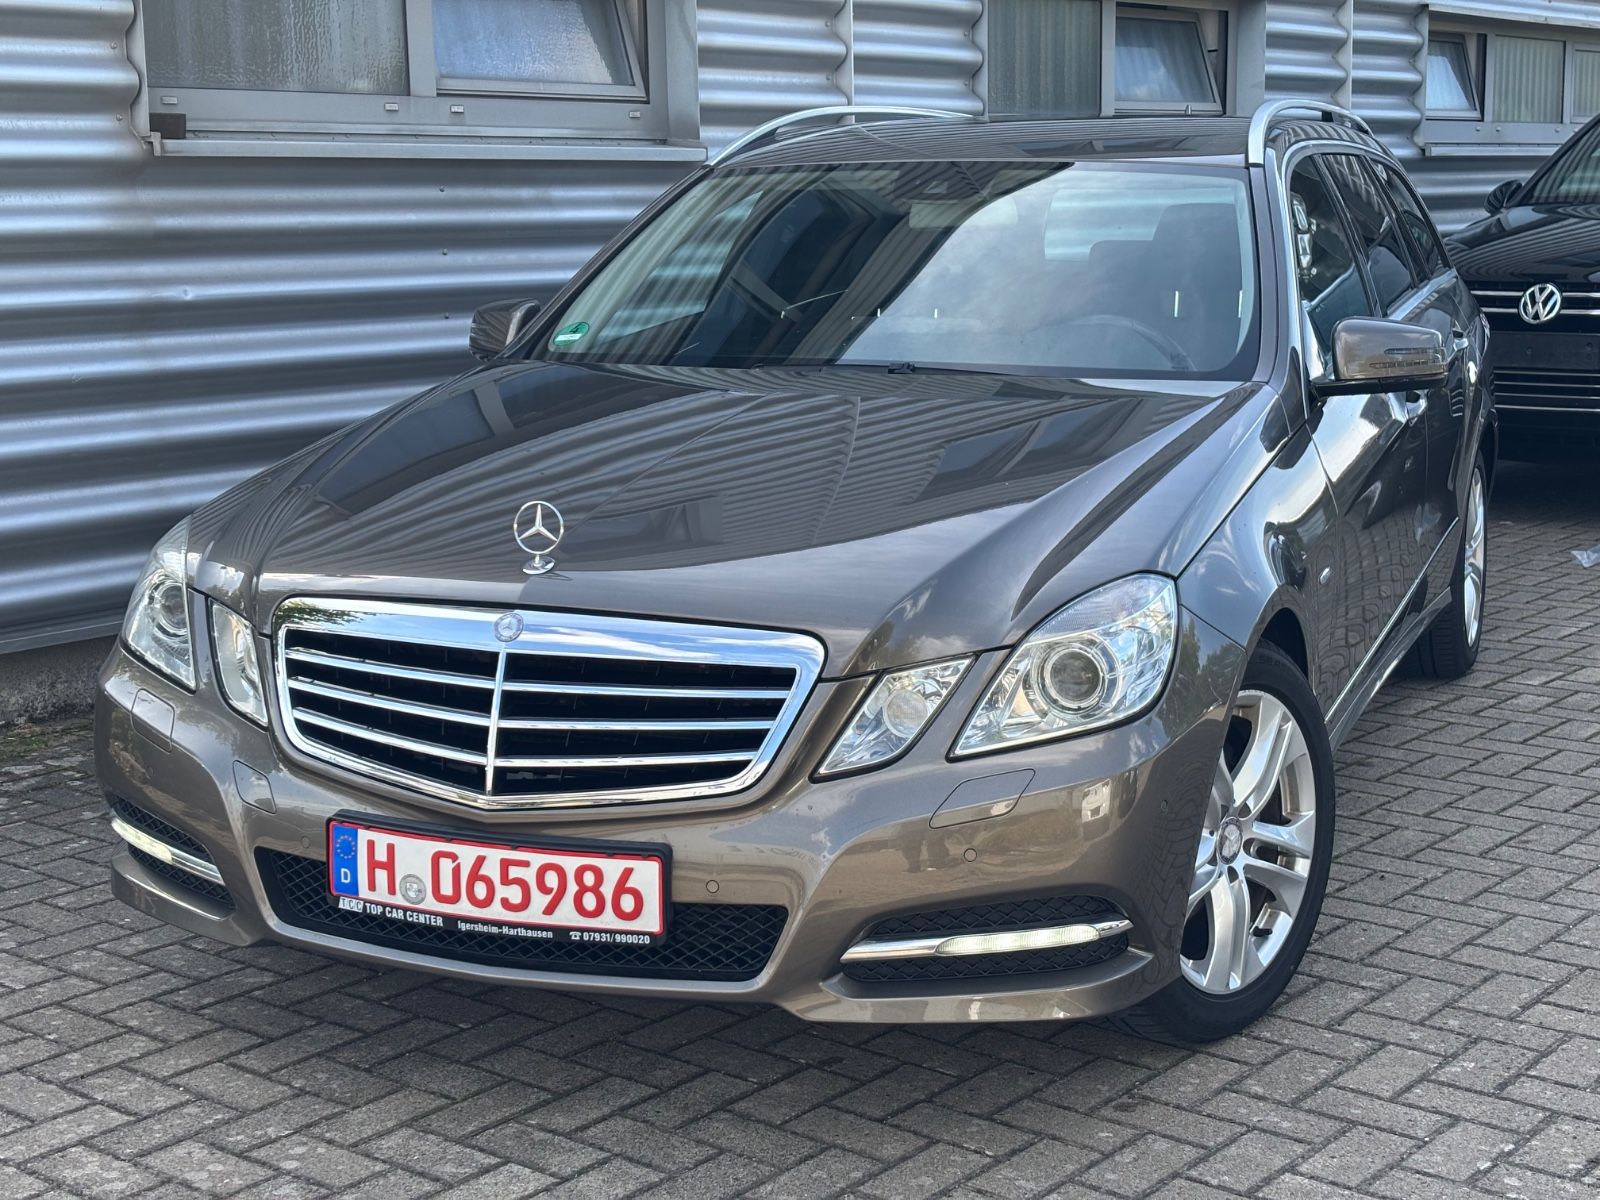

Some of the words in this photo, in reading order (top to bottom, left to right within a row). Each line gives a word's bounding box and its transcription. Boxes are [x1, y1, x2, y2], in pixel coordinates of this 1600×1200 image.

[341, 868, 351, 884] D
[366, 838, 396, 896] H
[430, 850, 645, 922] 065986
[338, 896, 364, 913] TCC
[365, 902, 384, 915] TOP
[385, 906, 405, 920] CAR
[406, 910, 444, 927] CENTER
[457, 919, 554, 939] Igersheim-Harthausen
[582, 931, 651, 945] 07931/990020
